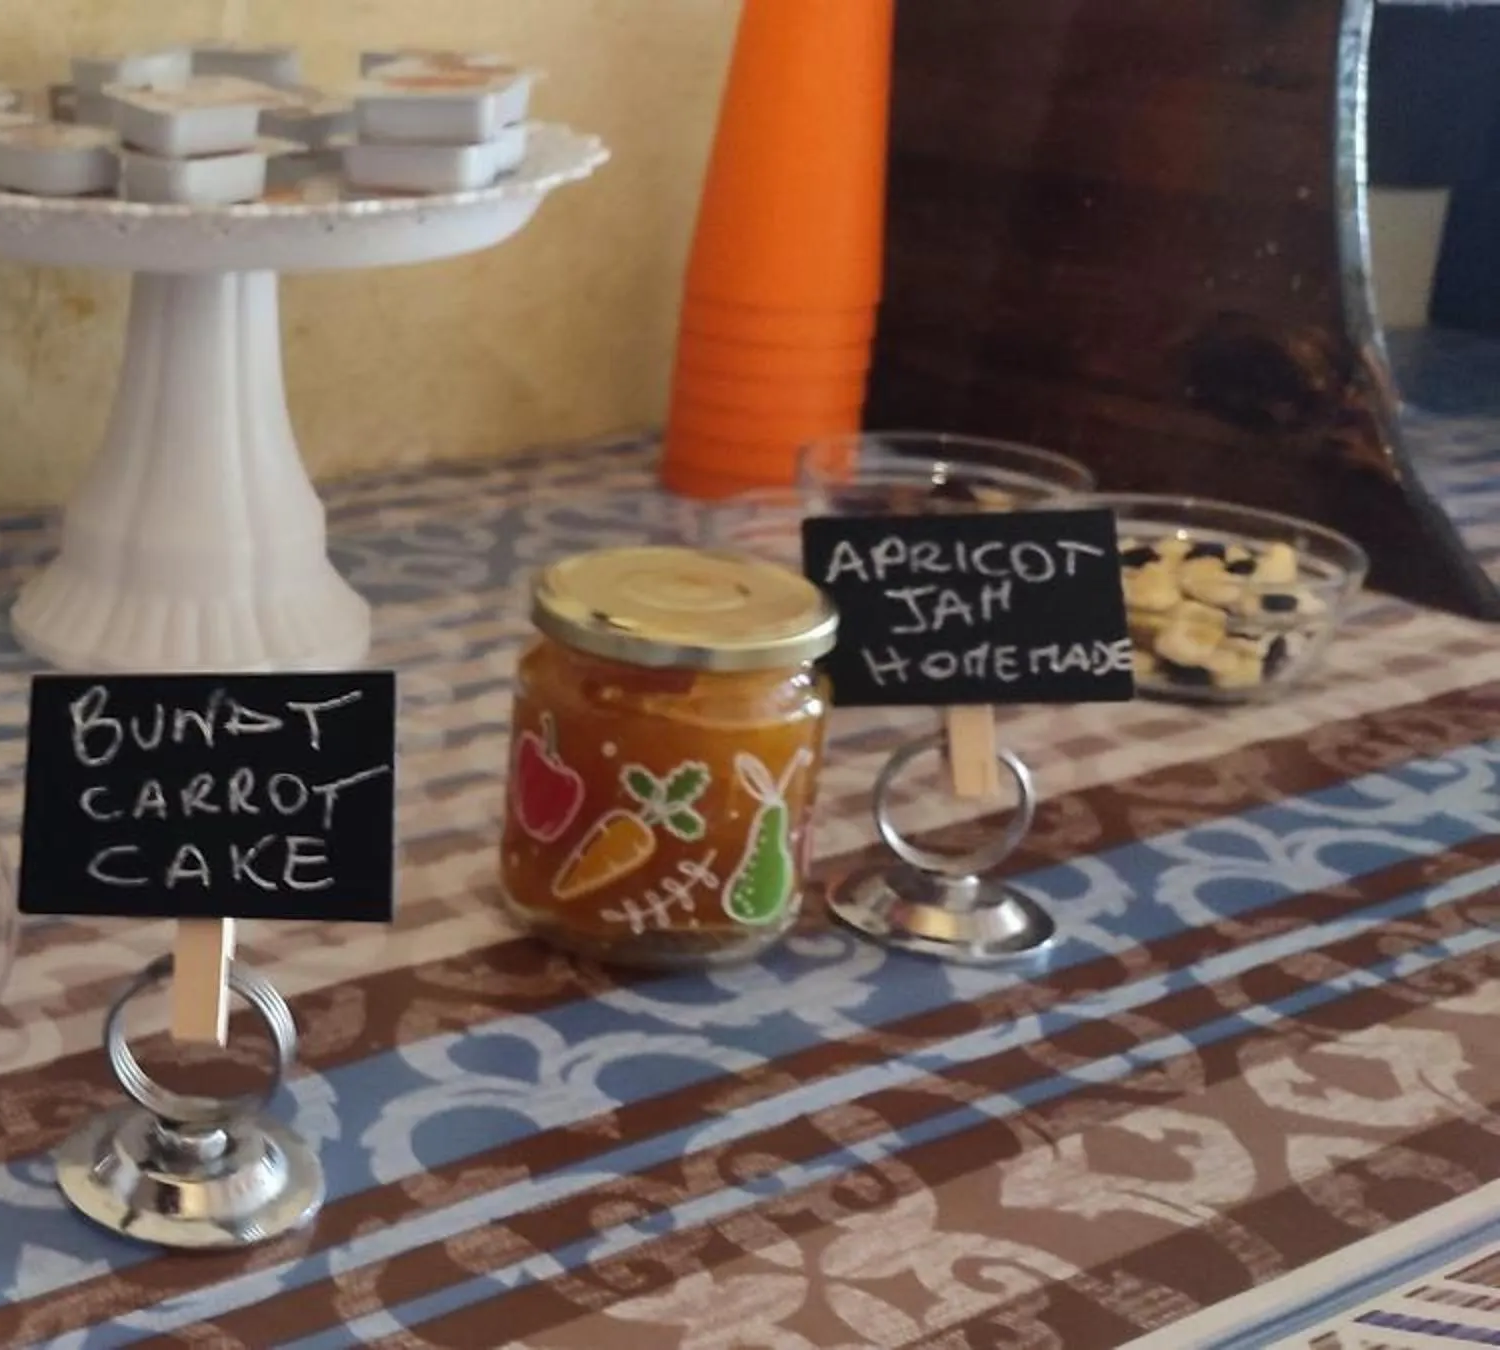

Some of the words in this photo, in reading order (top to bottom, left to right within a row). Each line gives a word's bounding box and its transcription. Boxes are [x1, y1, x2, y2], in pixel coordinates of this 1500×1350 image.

[826, 537, 1103, 582] APRICOT
[70, 686, 362, 766] BUNDT
[80, 765, 390, 829] CARROT
[87, 835, 335, 891] CAKE
